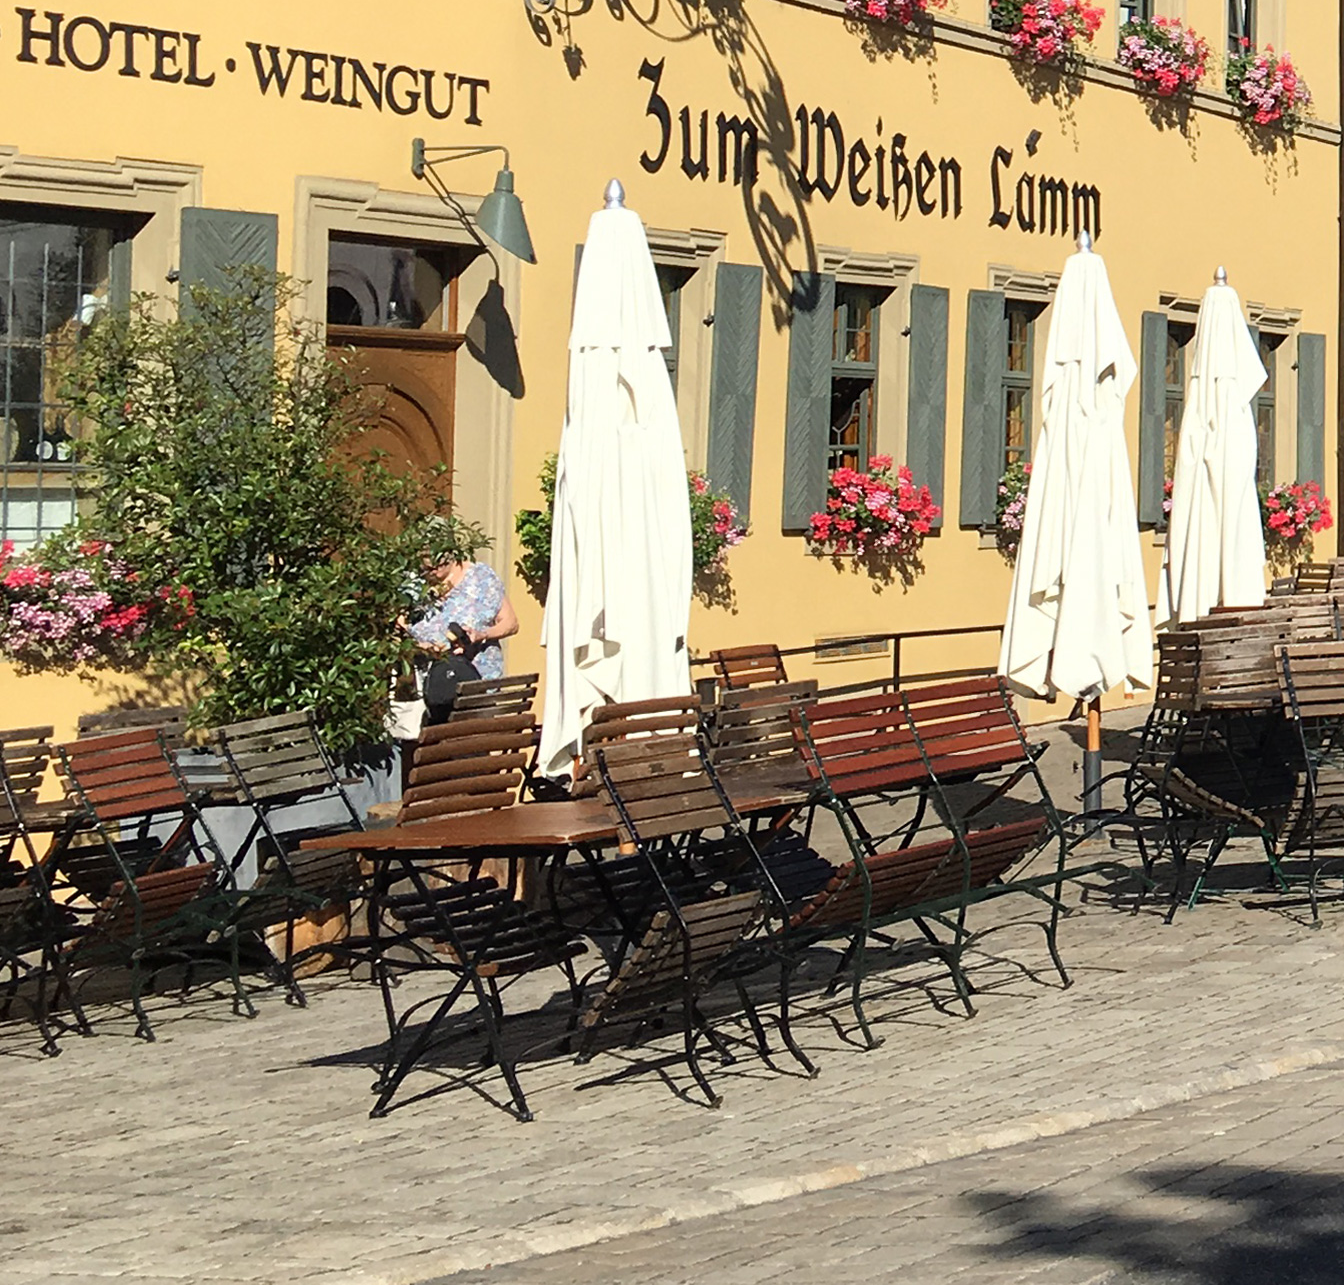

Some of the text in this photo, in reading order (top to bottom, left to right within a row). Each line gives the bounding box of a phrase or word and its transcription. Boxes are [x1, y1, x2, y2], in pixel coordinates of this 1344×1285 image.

[15, 7, 490, 127] HOTEL WEINGUT
[638, 56, 1102, 243] Zum Weißen Lamm
